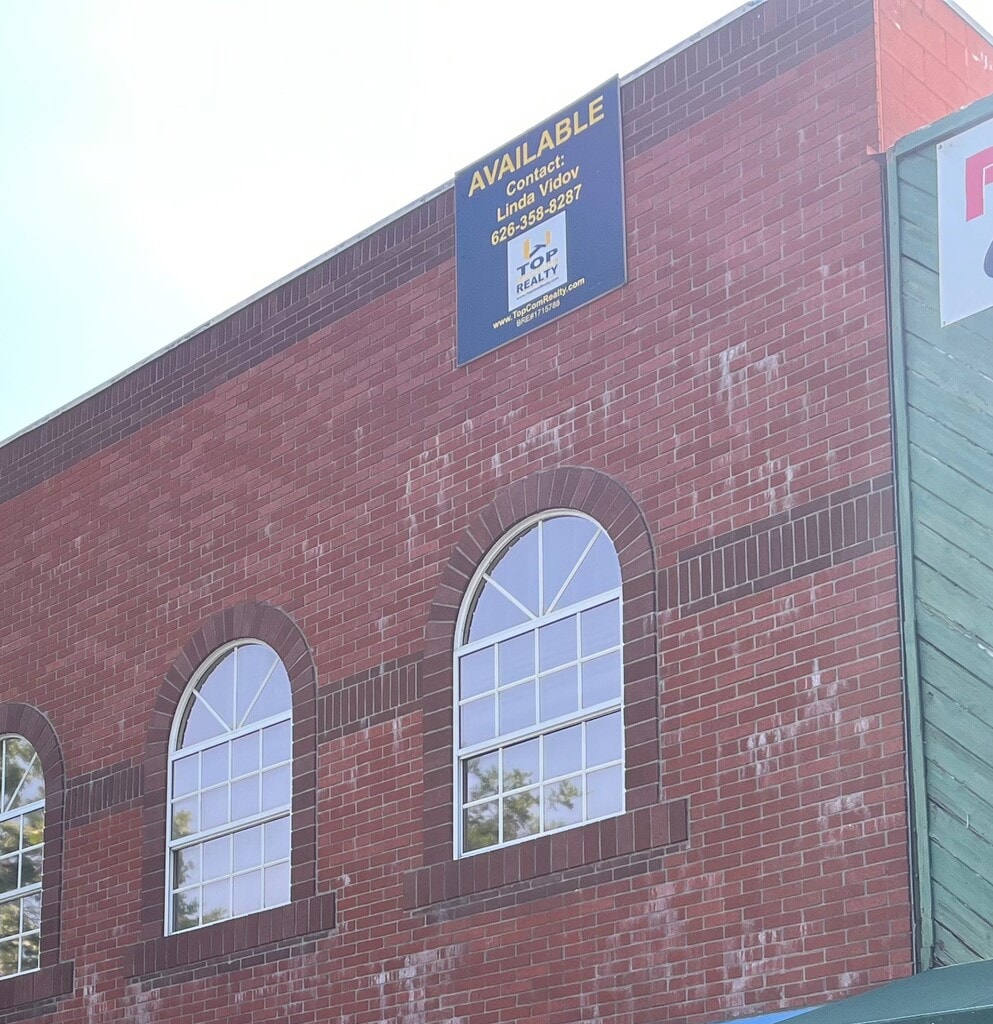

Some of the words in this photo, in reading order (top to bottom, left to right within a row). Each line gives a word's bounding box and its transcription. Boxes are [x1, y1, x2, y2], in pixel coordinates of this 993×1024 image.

[468, 95, 605, 198] AVAILABLE
[497, 191, 535, 222] Linda
[539, 165, 580, 196] Vidov
[506, 155, 565, 197] Contact:
[490, 184, 582, 246] 626-358-8287
[516, 248, 558, 276] TOP
[516, 264, 558, 293] REALTY
[492, 277, 585, 329] www.TopComRealty.com
